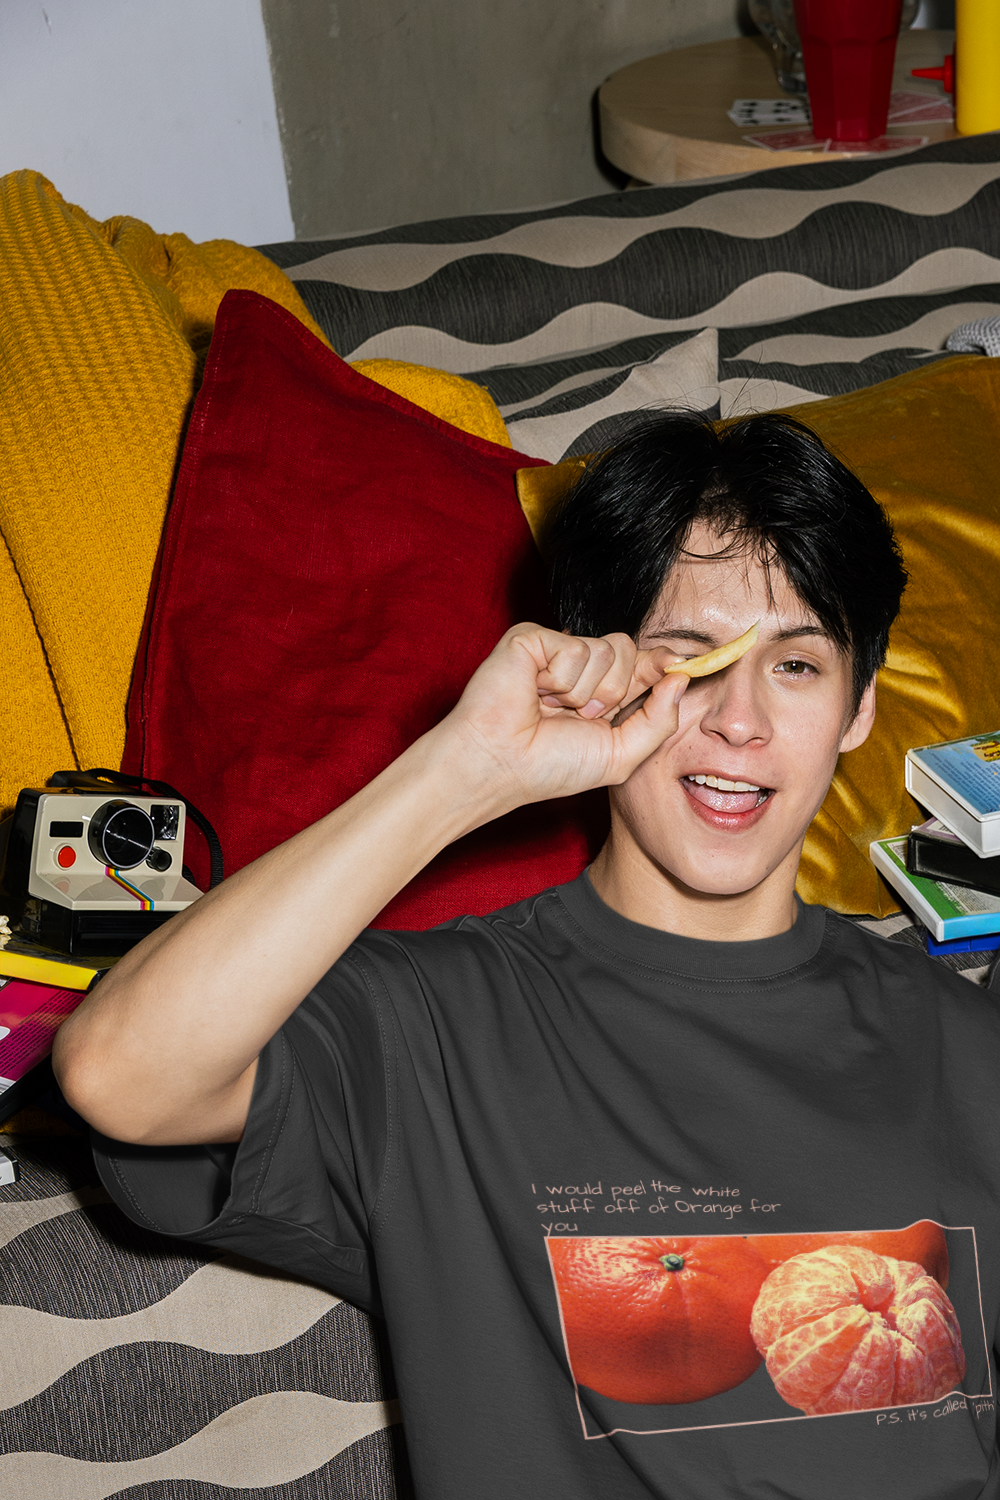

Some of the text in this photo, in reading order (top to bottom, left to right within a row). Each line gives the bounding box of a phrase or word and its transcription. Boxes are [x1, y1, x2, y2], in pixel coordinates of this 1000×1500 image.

[531, 1180, 741, 1201] I would peel the white
[537, 1196, 782, 1220] stuff off of Orange for
[540, 1221, 579, 1238] you
[908, 1409, 927, 1421] it's
[932, 1397, 968, 1418] called
